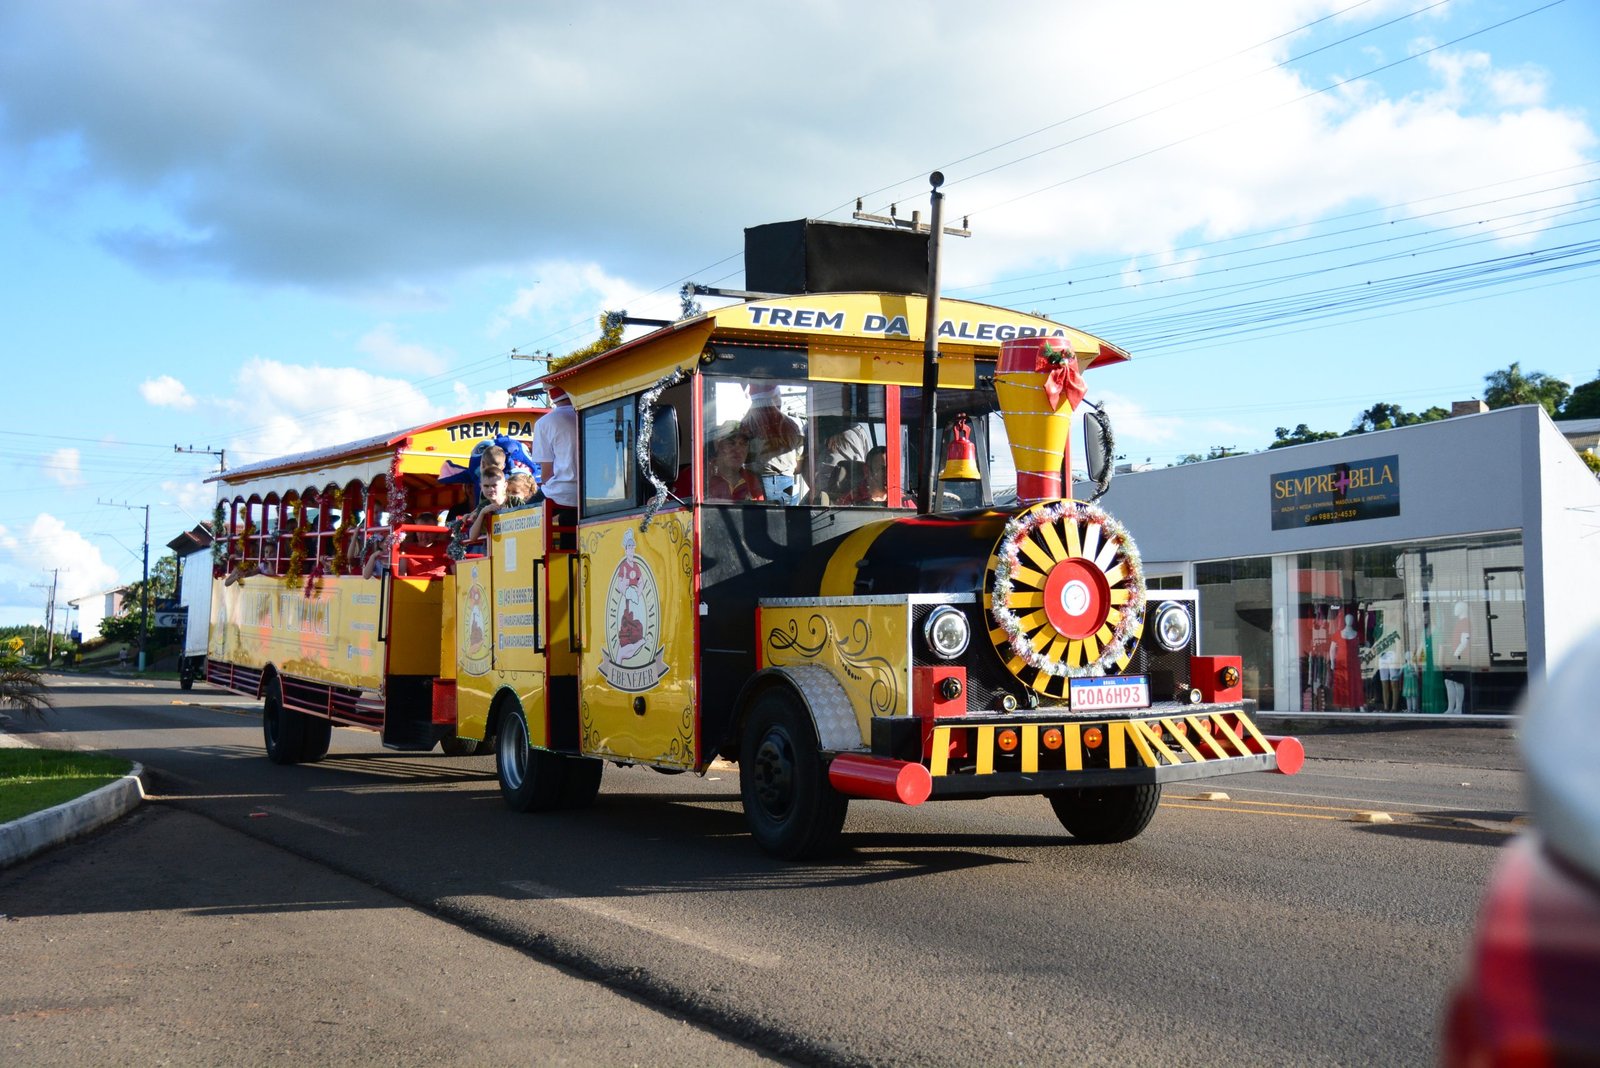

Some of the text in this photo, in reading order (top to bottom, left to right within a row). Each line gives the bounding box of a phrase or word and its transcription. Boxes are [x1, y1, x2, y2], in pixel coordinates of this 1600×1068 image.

[748, 306, 845, 329] TREM
[863, 315, 909, 336] DA
[447, 421, 533, 441] TREM DA
[612, 667, 654, 688] EBENÉZER
[1077, 687, 1140, 705] COA6H93
